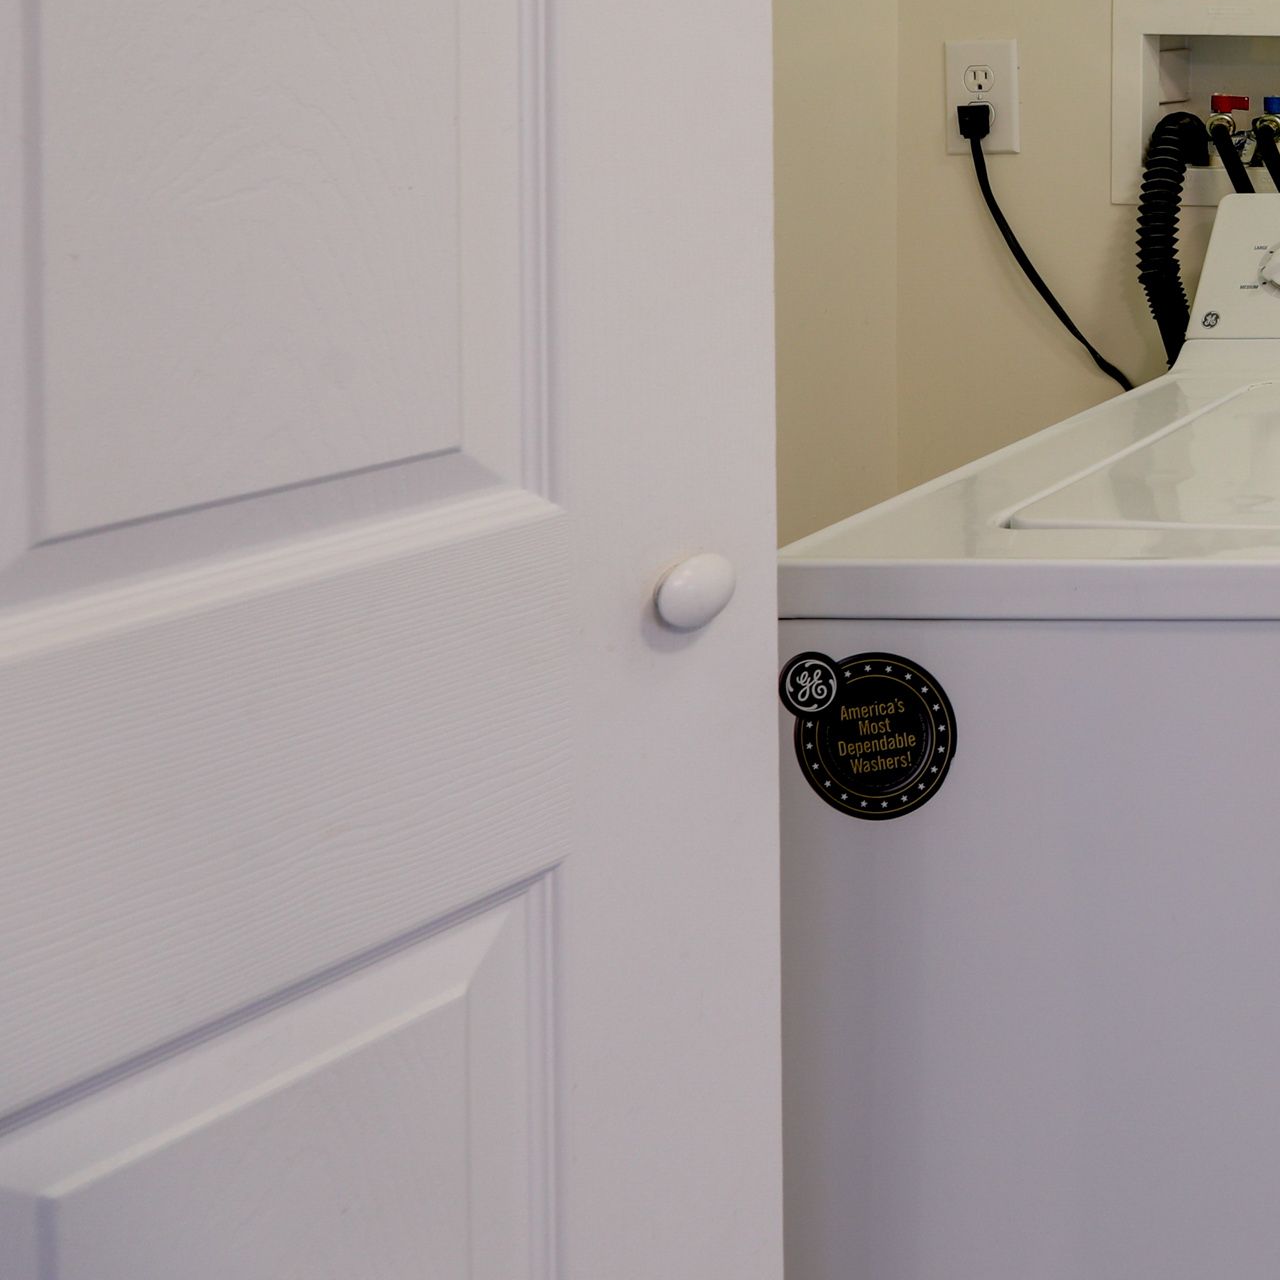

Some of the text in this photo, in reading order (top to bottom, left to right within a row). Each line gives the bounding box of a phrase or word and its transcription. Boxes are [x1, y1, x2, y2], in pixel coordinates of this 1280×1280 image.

[840, 698, 905, 721] America's
[858, 718, 892, 736] Most
[838, 732, 917, 757] Dependable
[850, 751, 913, 775] Washers!
